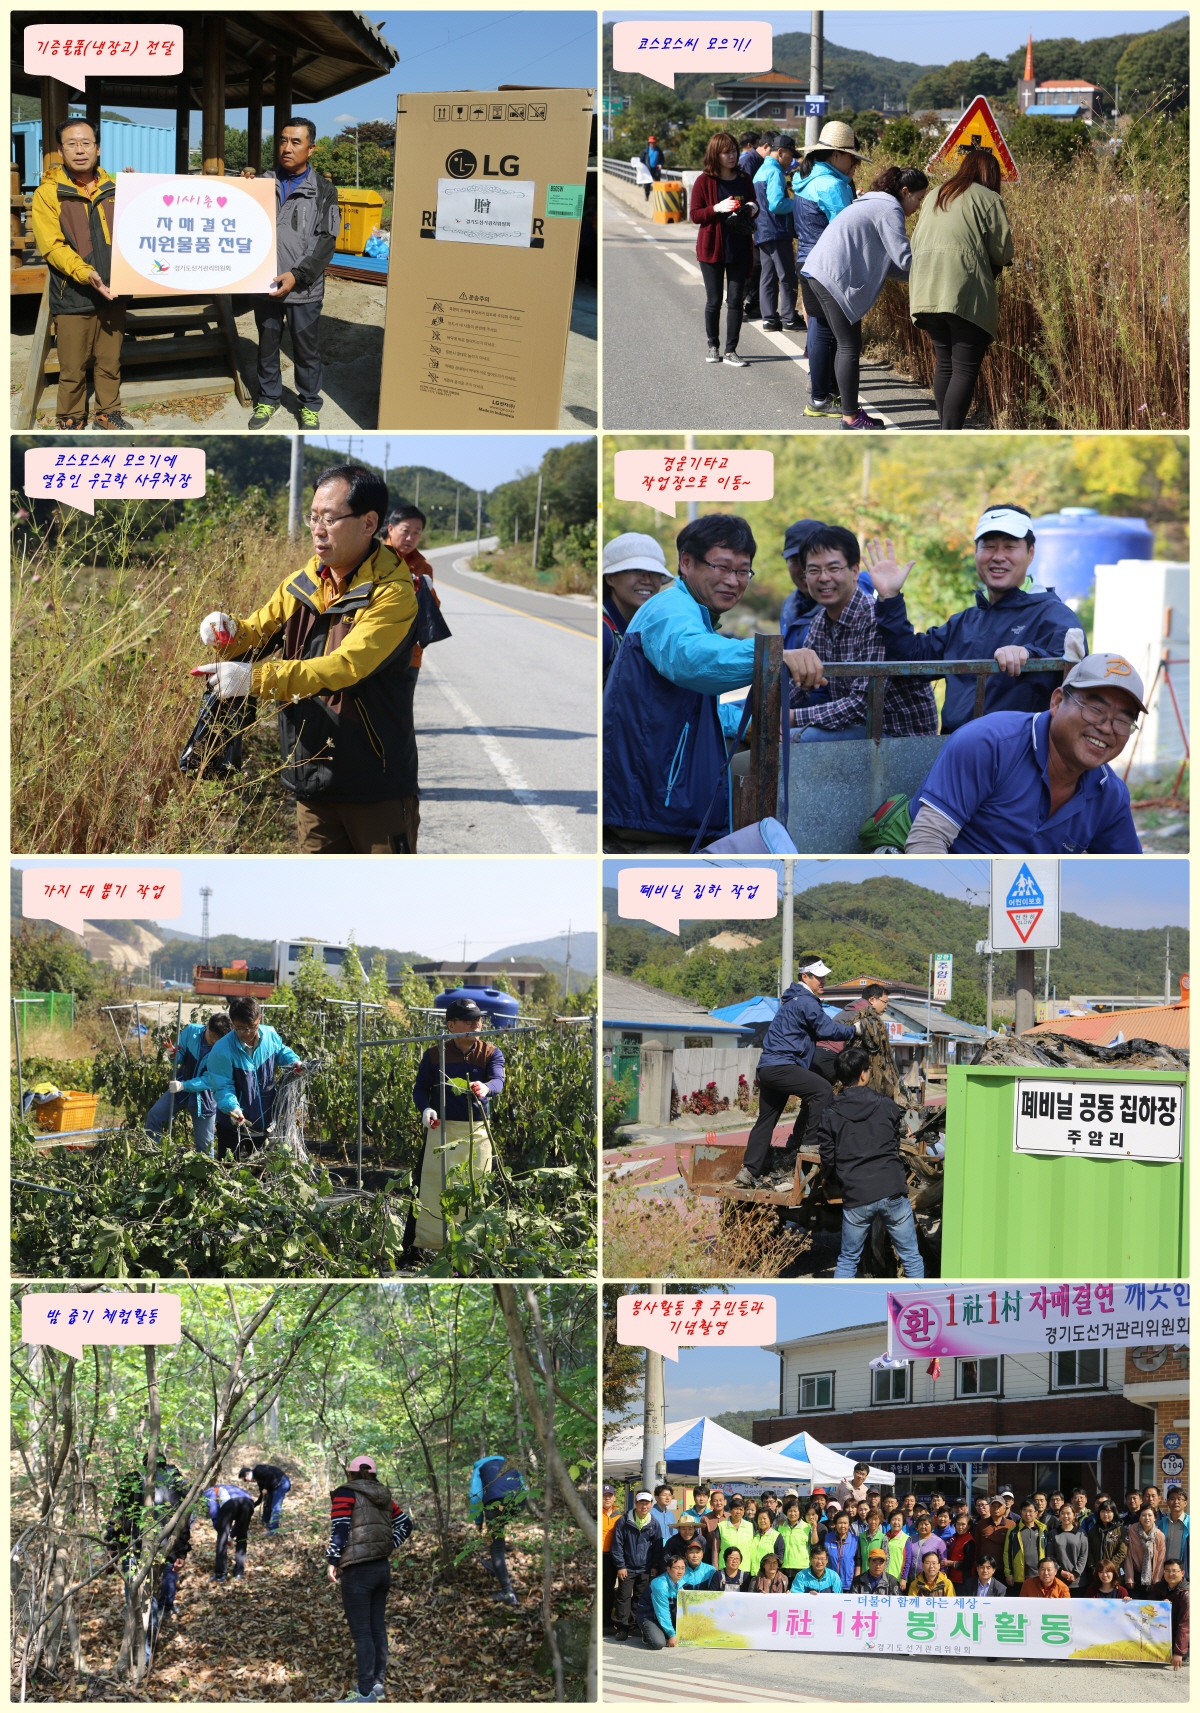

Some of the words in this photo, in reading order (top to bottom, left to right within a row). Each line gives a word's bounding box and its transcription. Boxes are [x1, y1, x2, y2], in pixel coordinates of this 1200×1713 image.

[810, 103, 820, 114] 21
[483, 154, 520, 177] LG
[156, 216, 236, 233] 자매결연
[139, 236, 211, 254] 지원물품
[218, 237, 253, 254] 전달
[174, 264, 232, 272] 경기도선거관리위원회
[1008, 897, 1042, 906] 어린이보호
[1021, 1090, 1073, 1120] 폐비닐
[1079, 1092, 1114, 1123] 공동
[1119, 1094, 1177, 1126] 집하장
[1067, 1129, 1124, 1148] 주암리
[1029, 1283, 1115, 1319] 자매결연
[902, 1307, 935, 1342] 환
[1045, 1317, 1190, 1345] 경기도선거관리위원회
[1166, 1437, 1179, 1445] ADT
[890, 1463, 910, 1473] 주암리
[916, 1463, 957, 1473] 마을회관
[857, 1595, 891, 1607] 더불어
[897, 1596, 920, 1609] 함께
[925, 1597, 949, 1609] 하는
[953, 1597, 978, 1610] 세상
[767, 1609, 812, 1636] 1社
[832, 1610, 879, 1638] 1村
[906, 1609, 1073, 1646] 봉사활동
[877, 1642, 971, 1655] 경기도선거관리위원회
